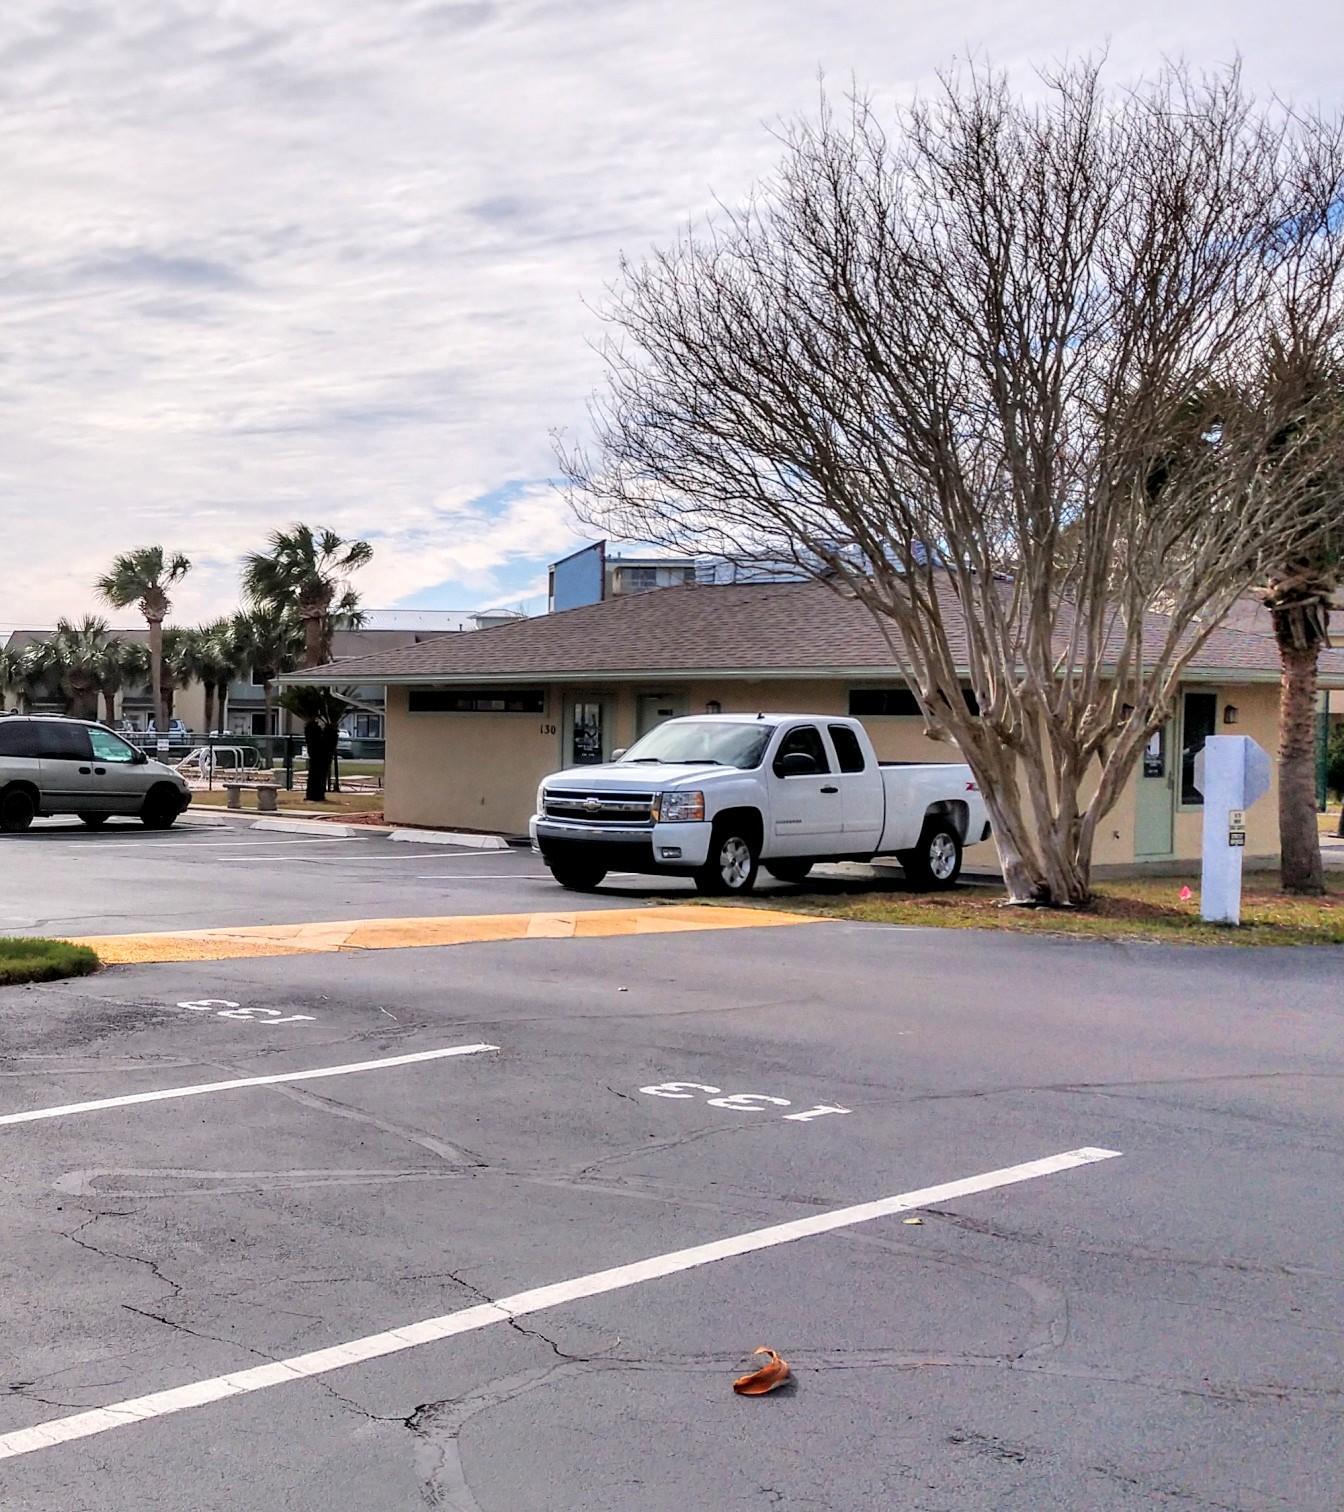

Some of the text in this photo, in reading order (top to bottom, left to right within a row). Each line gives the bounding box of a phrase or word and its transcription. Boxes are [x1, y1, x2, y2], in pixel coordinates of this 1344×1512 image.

[540, 724, 556, 735] 130
[176, 999, 316, 1025] 133
[638, 1082, 853, 1122] 133
